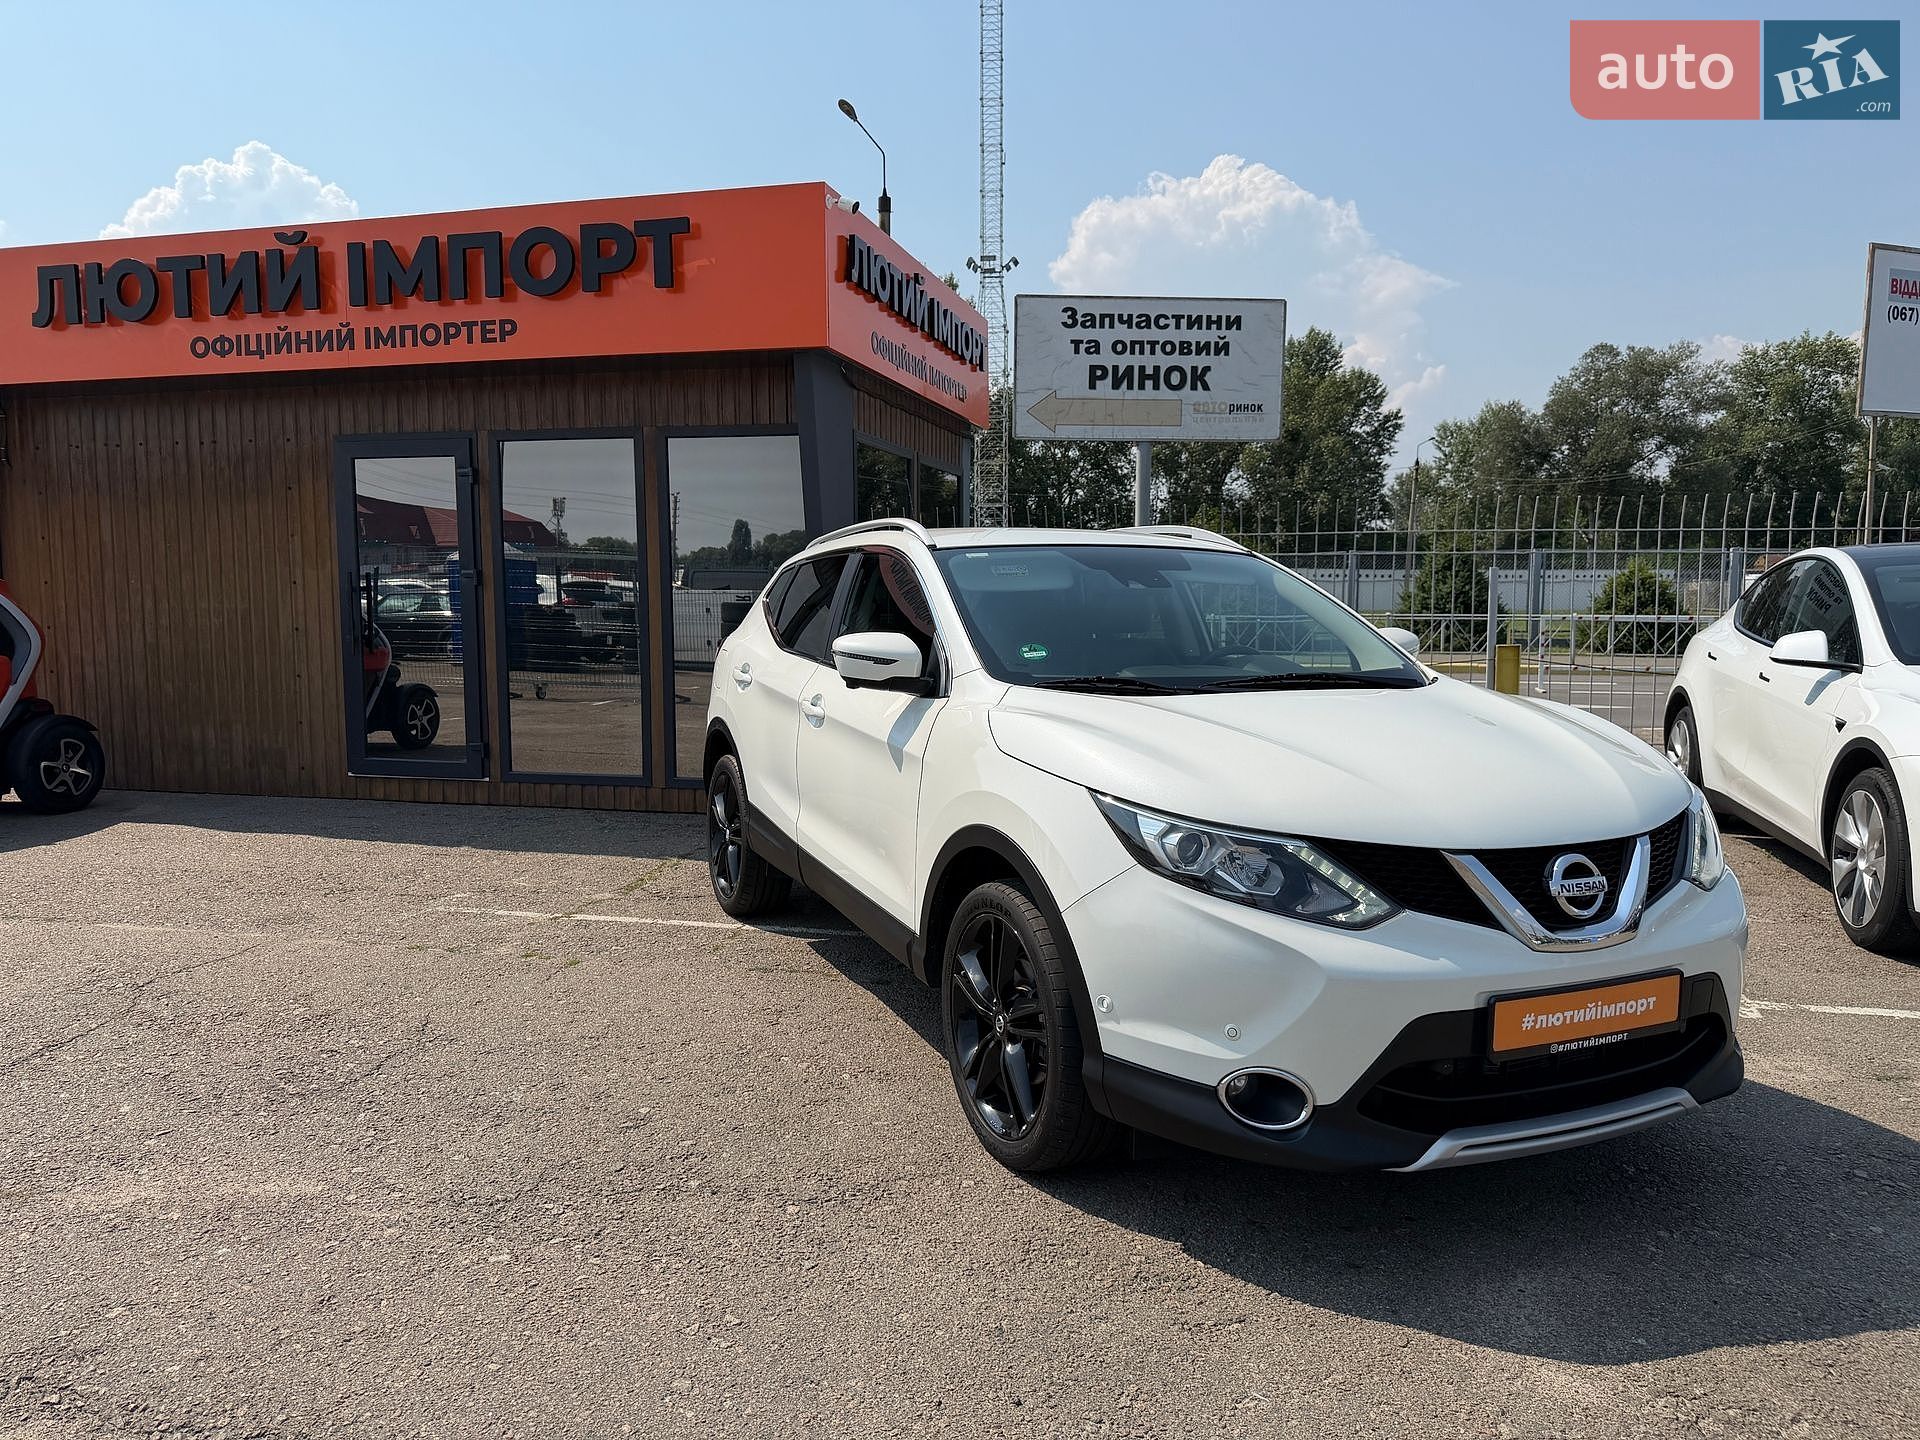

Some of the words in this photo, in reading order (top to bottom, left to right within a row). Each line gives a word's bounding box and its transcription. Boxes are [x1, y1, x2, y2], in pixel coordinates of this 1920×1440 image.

[32, 230, 321, 328] ЛЮТИЙ
[346, 216, 691, 307] ІМПОРТ
[848, 234, 930, 335] ЛЮТИЙ
[1061, 306, 1242, 331] Запчастини
[1888, 305, 1919, 325] (067)
[189, 321, 355, 360] ОФІЦІЙНИЙ
[364, 318, 518, 350] ІМПОРТЕР
[1070, 339, 1101, 356] та
[1111, 335, 1230, 356] оптовий
[871, 331, 928, 383] ОФІЦІЙНИЙ
[929, 365, 967, 403] ІМПОРТЕР
[1088, 364, 1212, 391] РИНОК
[1560, 880, 1605, 894] NISSAN
[1521, 996, 1657, 1031] #лютийімпорт
